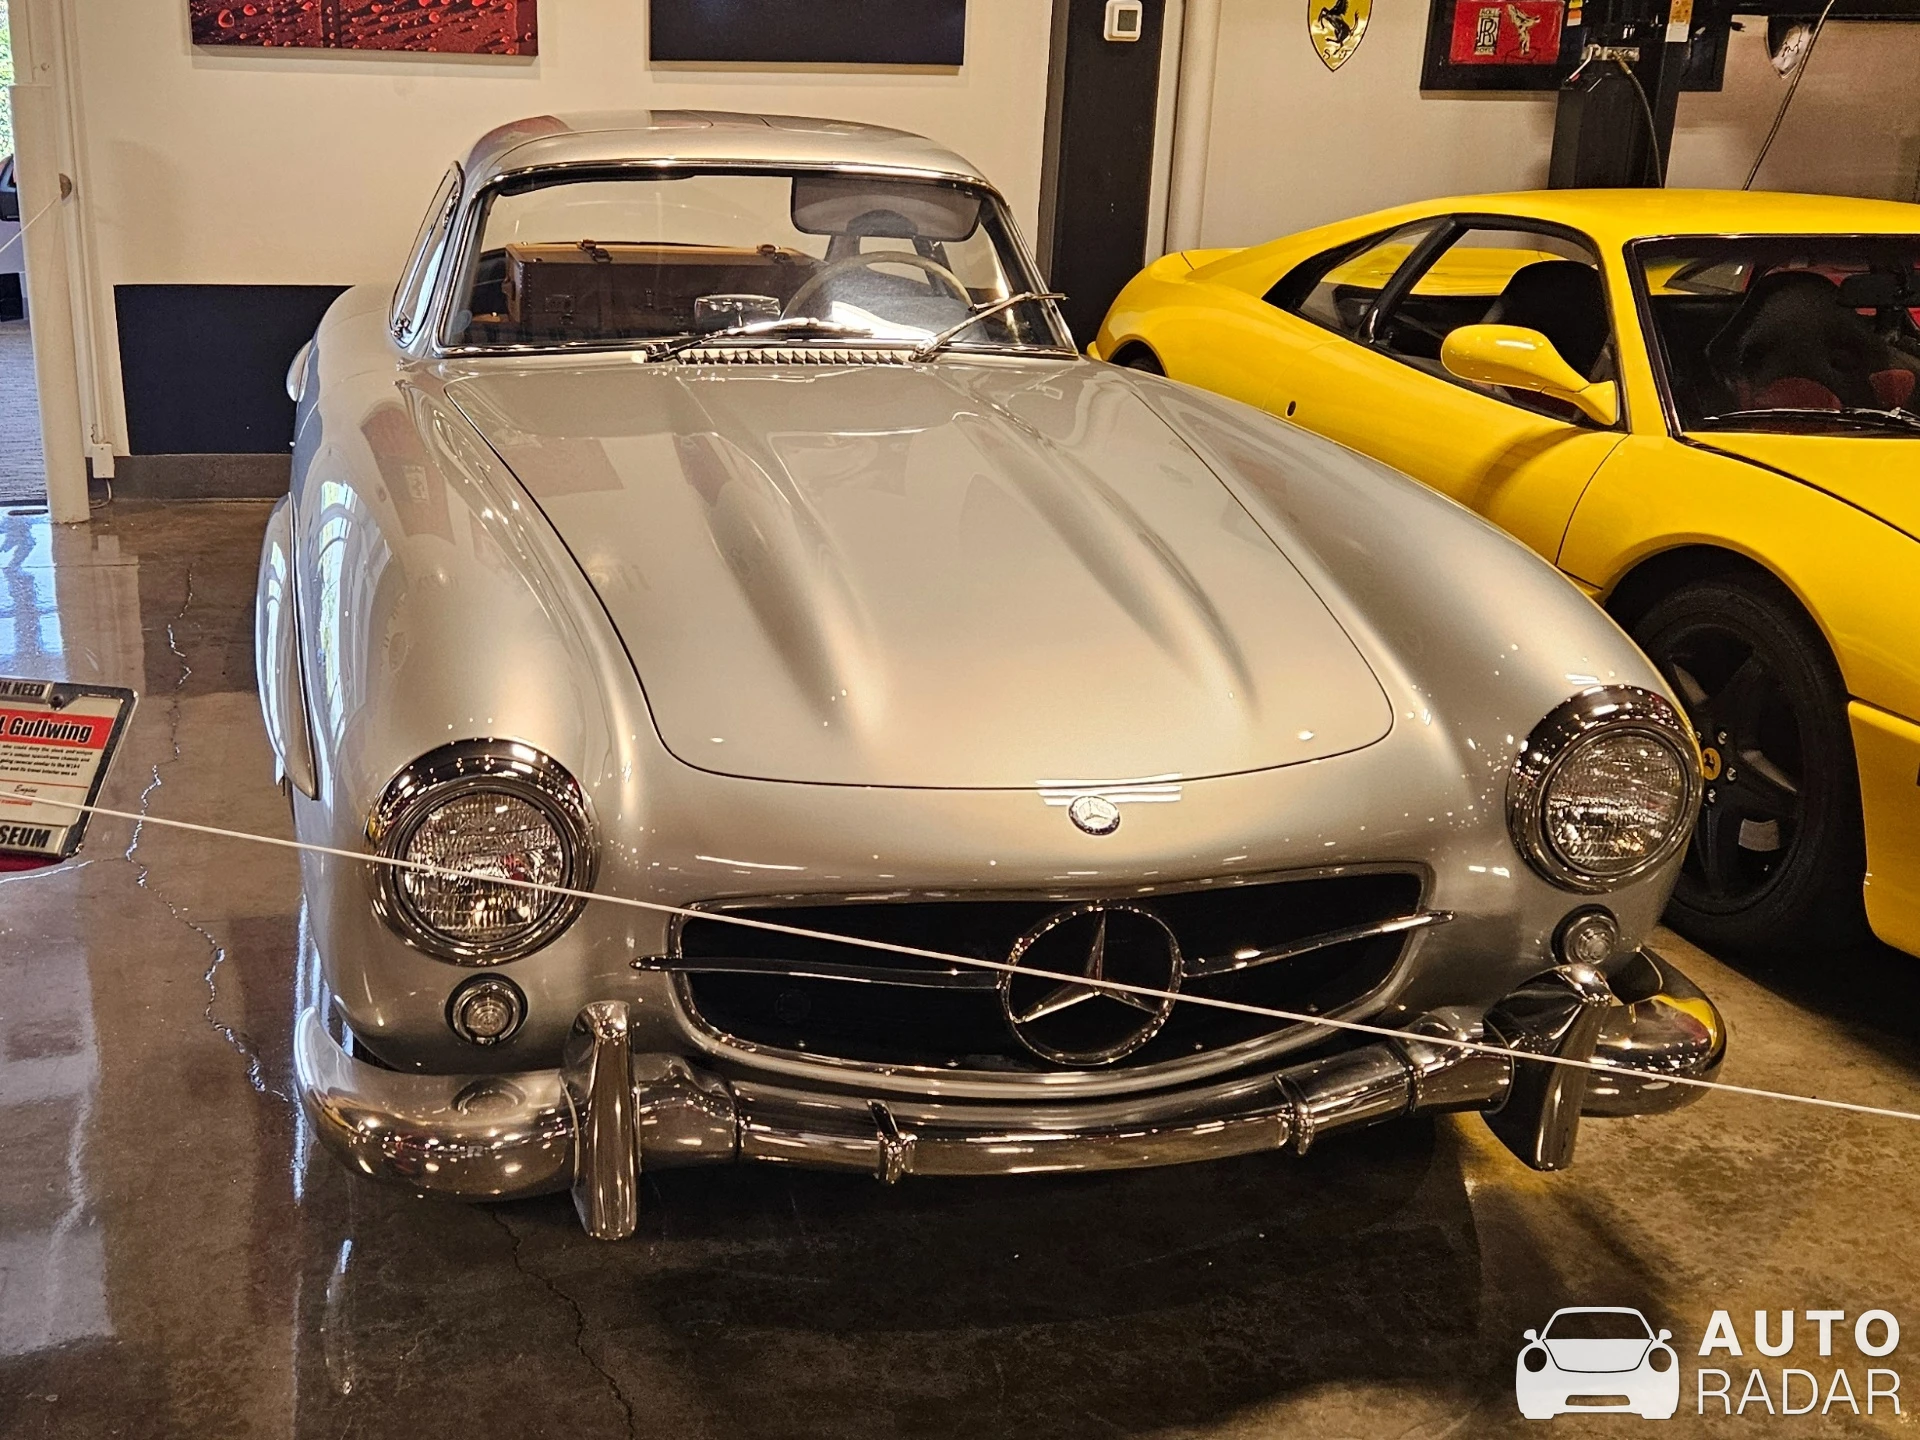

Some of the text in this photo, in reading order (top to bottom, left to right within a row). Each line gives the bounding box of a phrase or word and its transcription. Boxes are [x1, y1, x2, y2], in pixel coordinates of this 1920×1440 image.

[12, 682, 46, 697] NEED
[9, 717, 93, 743] Gullwing
[0, 825, 52, 849] SEUM
